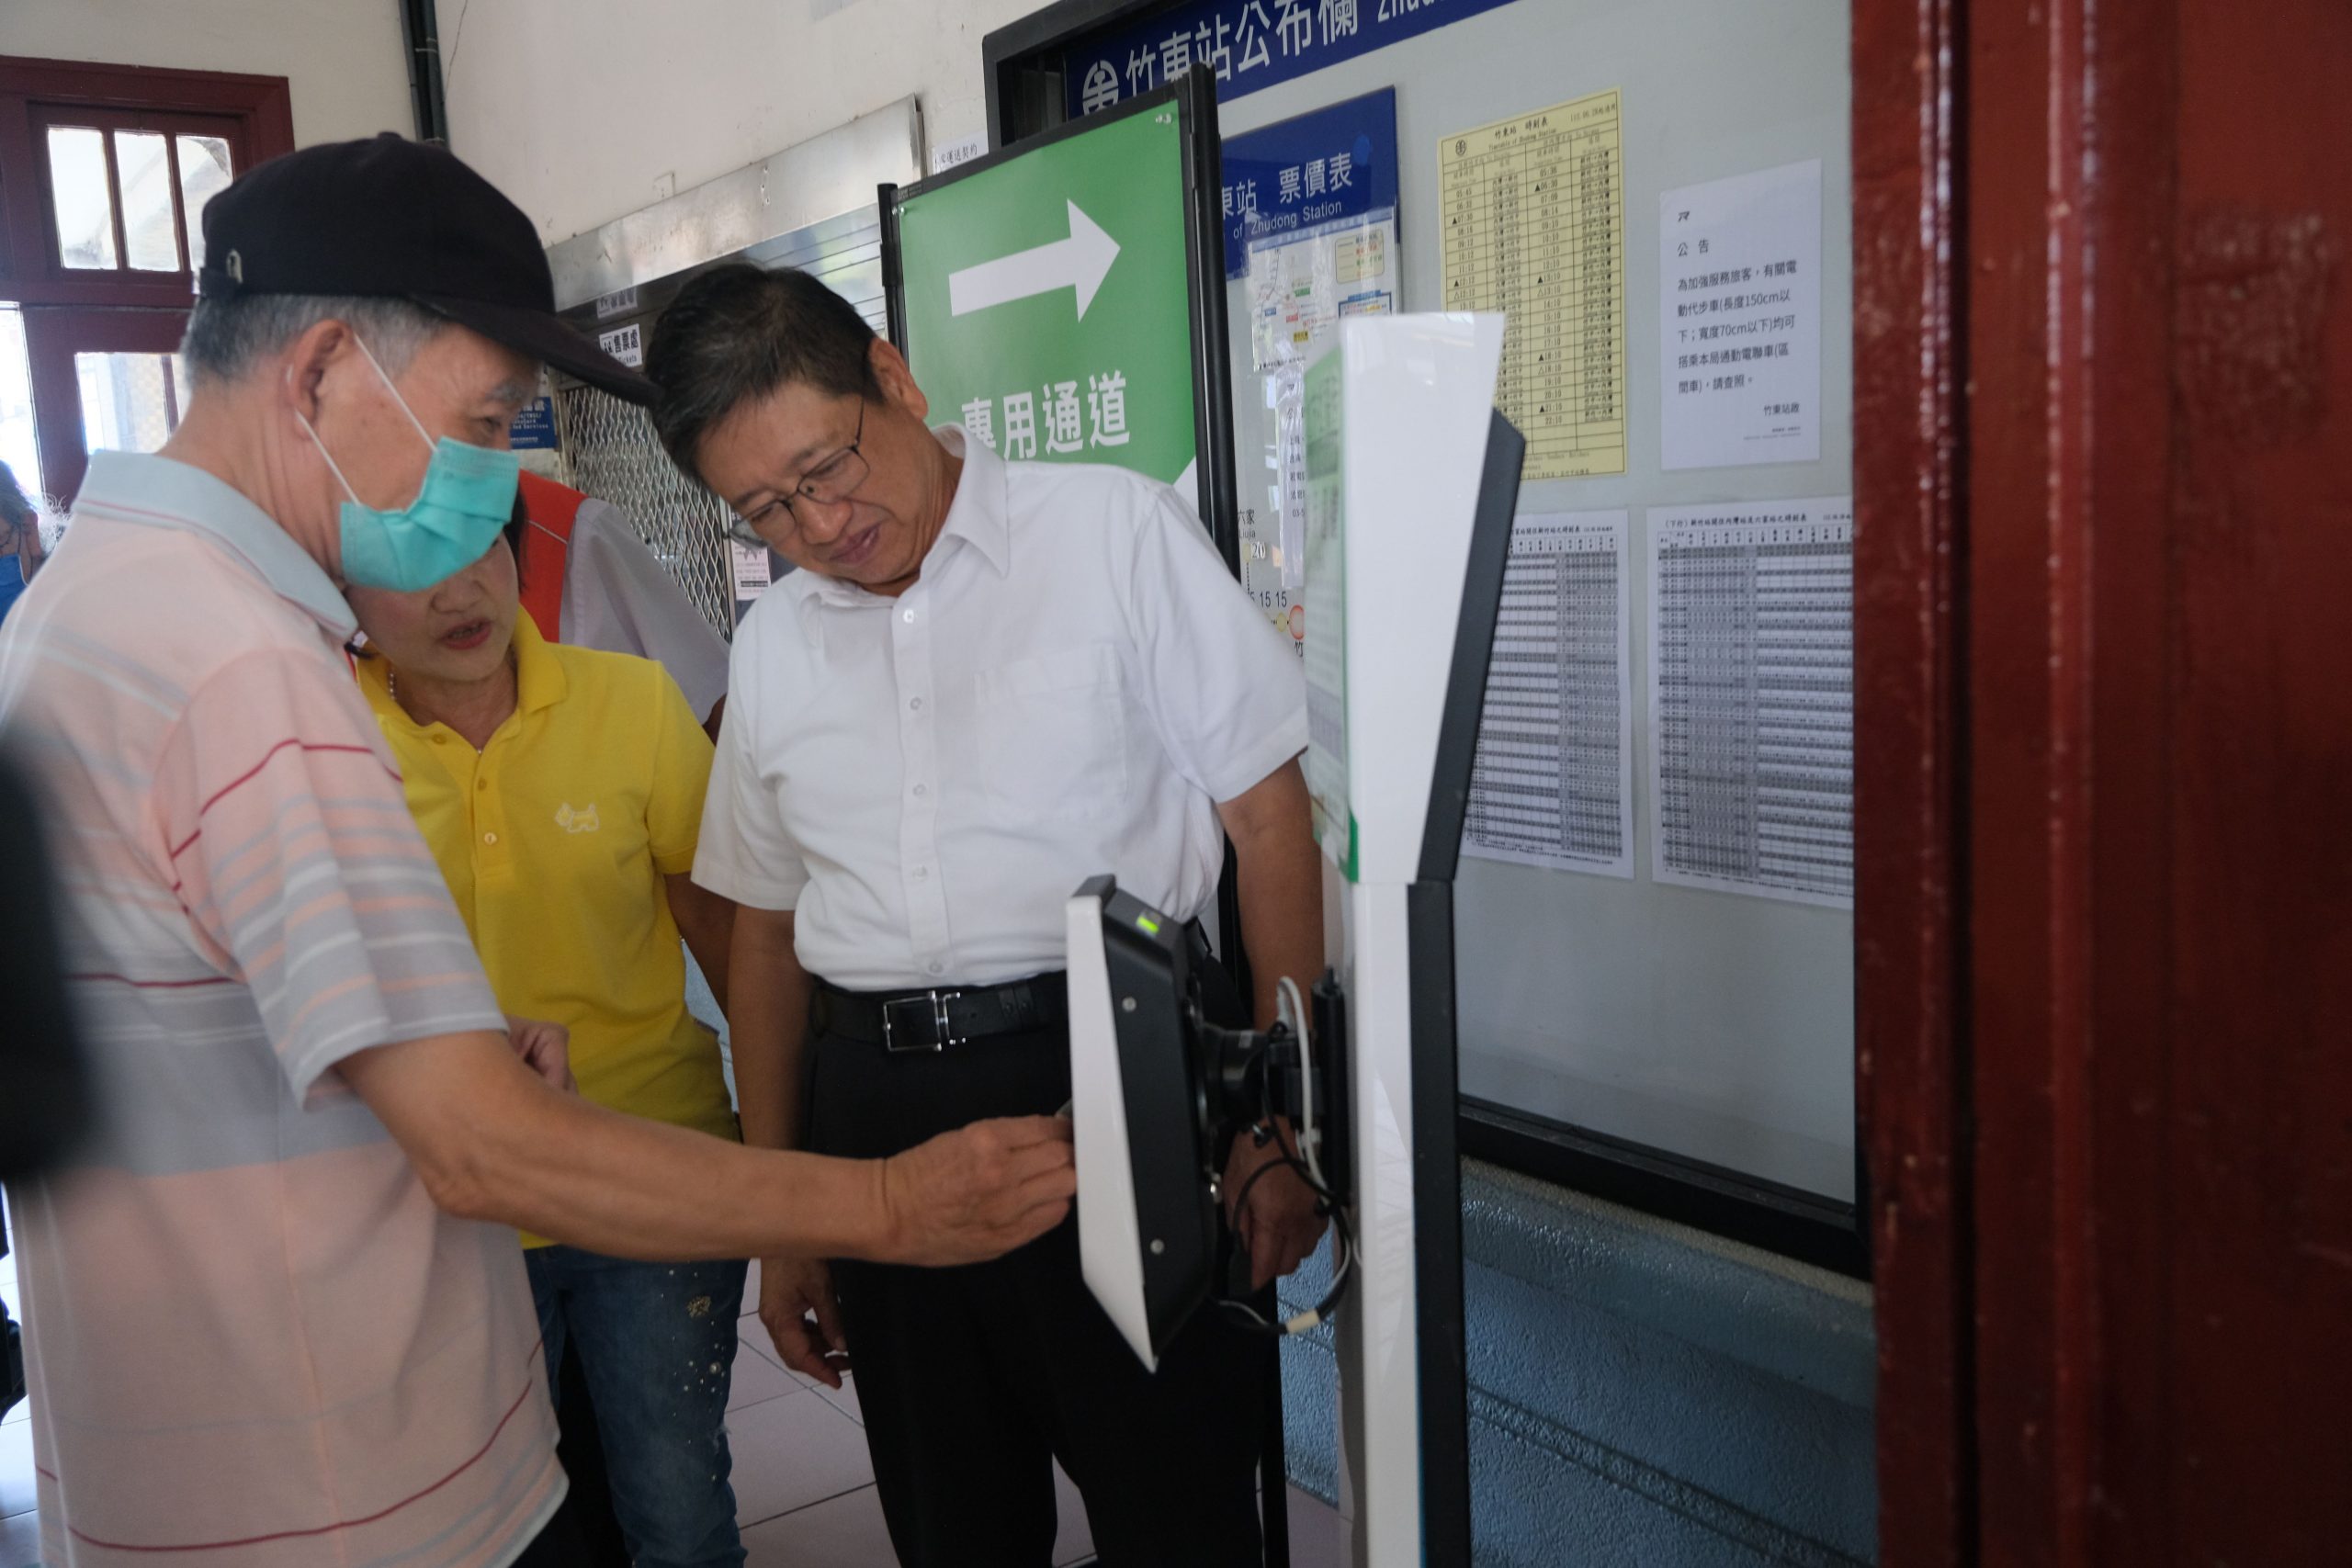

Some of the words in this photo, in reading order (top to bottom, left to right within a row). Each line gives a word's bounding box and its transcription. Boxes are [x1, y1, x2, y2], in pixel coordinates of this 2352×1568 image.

[1125, 0, 1358, 97] 竹東站公布欄
[1279, 152, 1352, 204] 票價表
[1233, 222, 1243, 239] of
[1250, 212, 1297, 235] Zhudong
[1303, 201, 1342, 221] Station
[961, 369, 1130, 460] 專用通道
[1260, 591, 1272, 608] 15
[1276, 591, 1287, 608] 15
